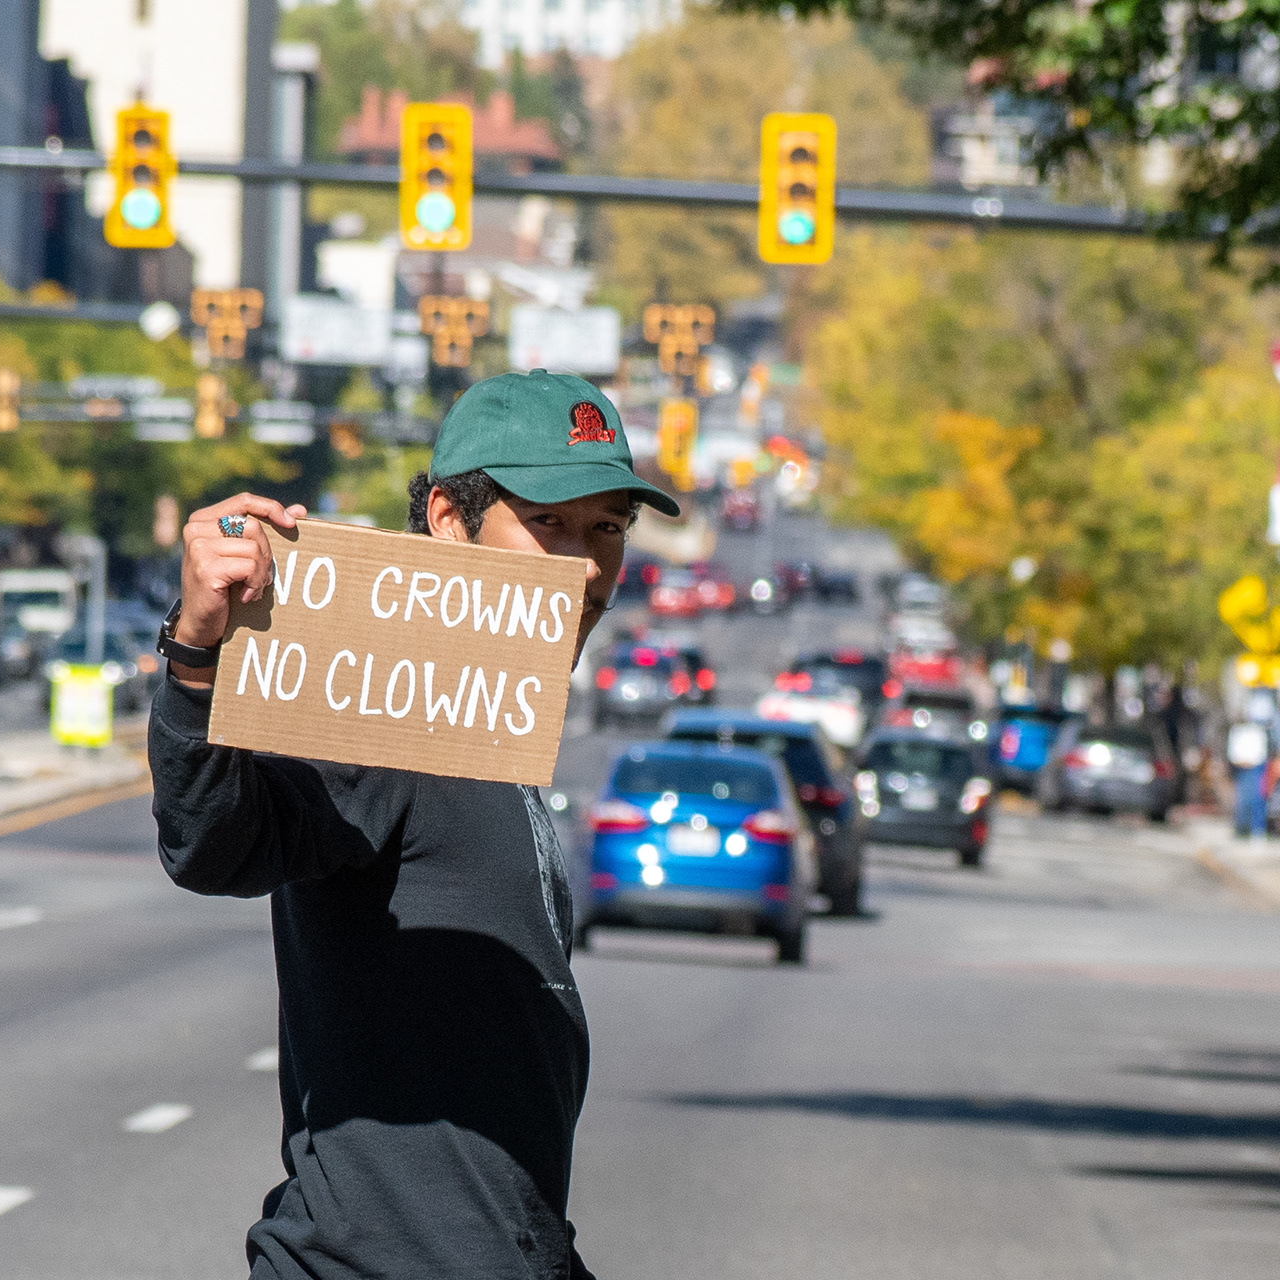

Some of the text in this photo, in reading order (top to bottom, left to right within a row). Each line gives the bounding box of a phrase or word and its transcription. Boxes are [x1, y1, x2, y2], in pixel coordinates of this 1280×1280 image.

[272, 550, 572, 643] NO CROWNS
[235, 636, 543, 737] NO CLOWNS
